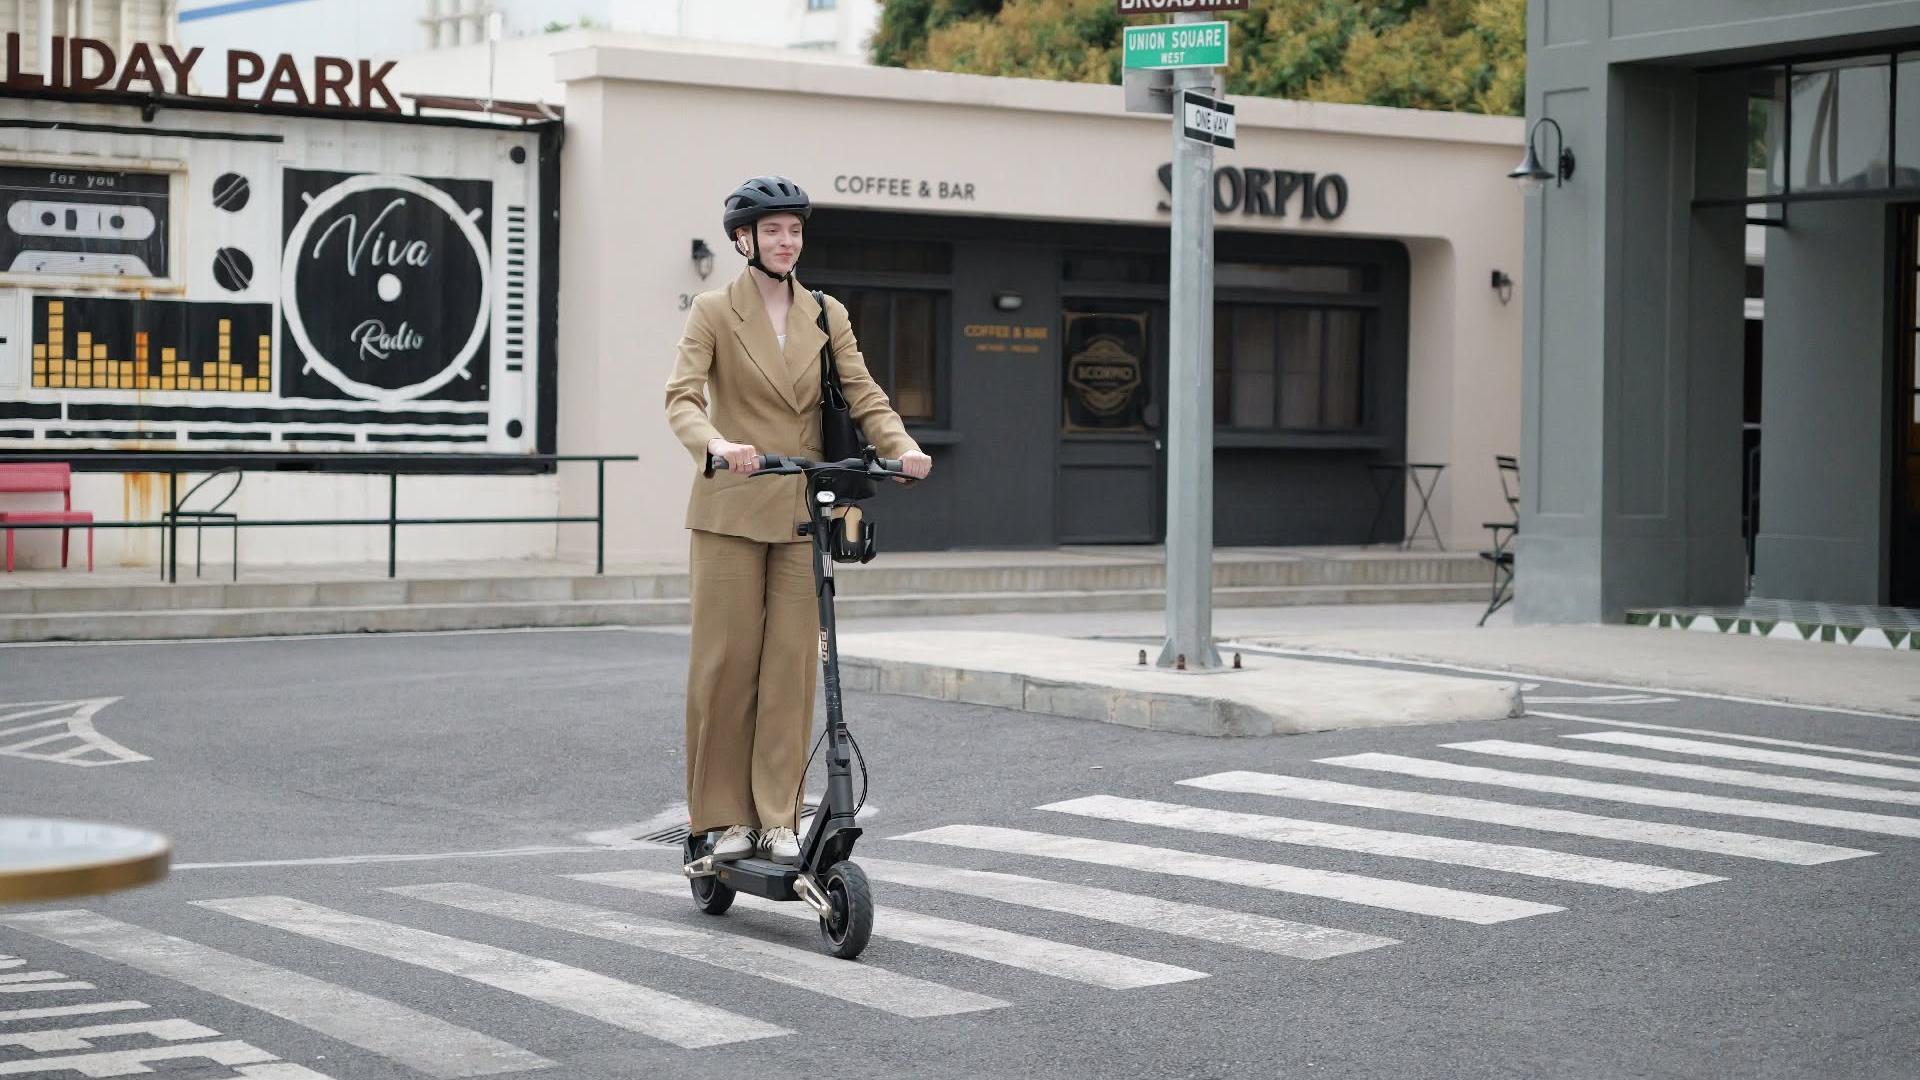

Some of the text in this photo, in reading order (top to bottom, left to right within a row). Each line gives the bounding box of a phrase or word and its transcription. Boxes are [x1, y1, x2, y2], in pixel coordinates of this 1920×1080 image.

[1128, 28, 1221, 51] UNION SQUARE
[1160, 51, 1185, 64] WEST
[227, 49, 402, 113] PARK
[1195, 108, 1211, 130] ONE
[49, 171, 116, 188] for you
[834, 174, 976, 200] COFFEE & BAR
[1156, 162, 1349, 221] SORPIO
[313, 197, 432, 276] Viva
[350, 318, 425, 361] Radio
